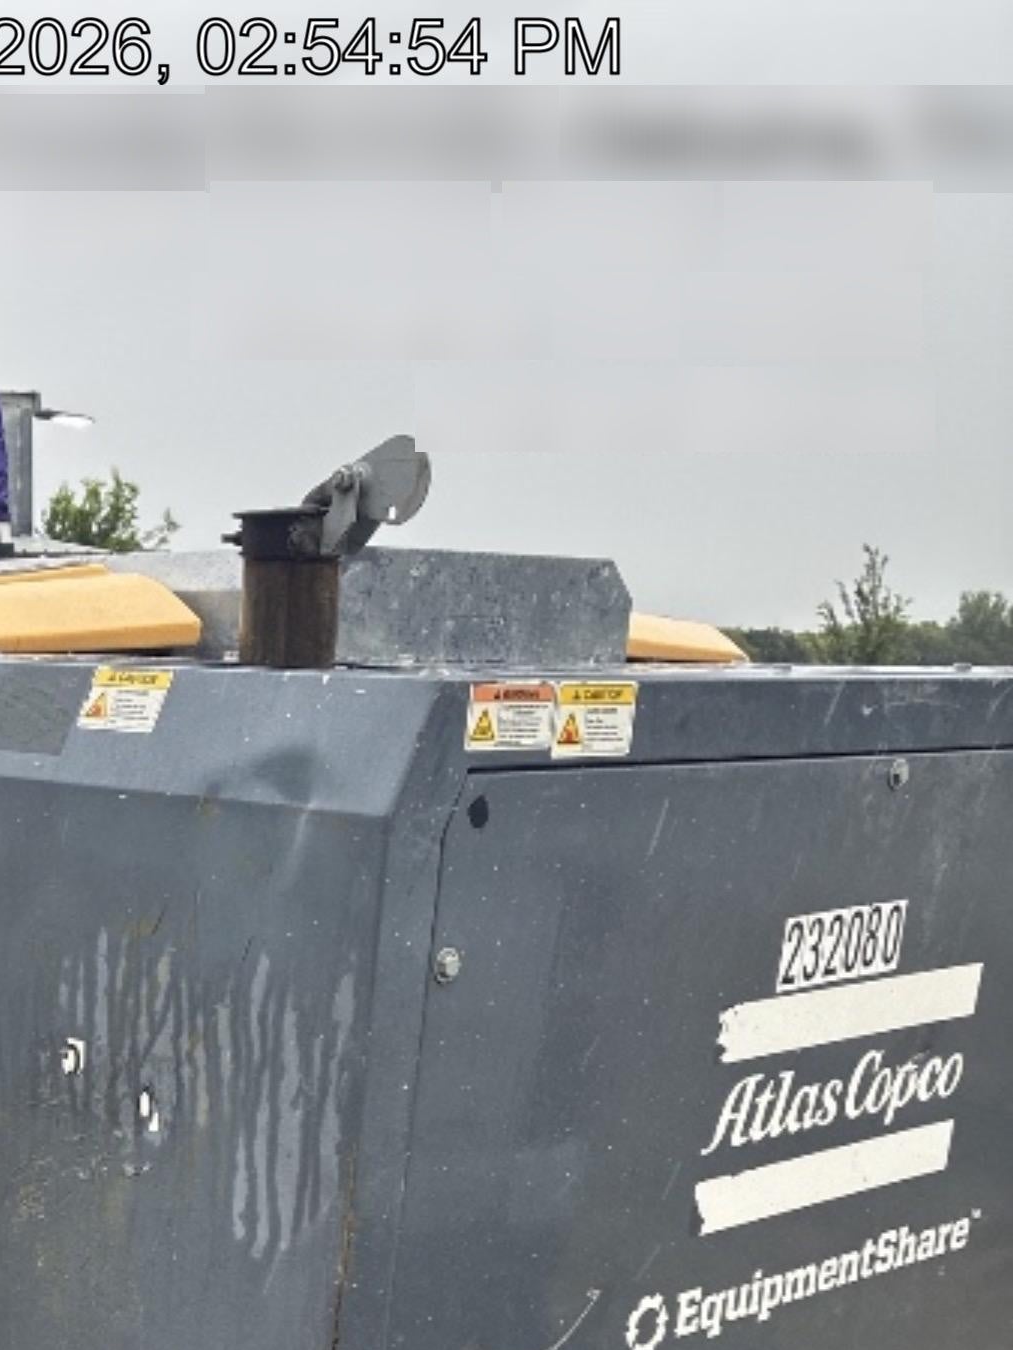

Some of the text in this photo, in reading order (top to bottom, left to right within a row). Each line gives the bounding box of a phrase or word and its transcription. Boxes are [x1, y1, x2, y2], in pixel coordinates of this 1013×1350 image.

[781, 904, 902, 984] 232080
[700, 1049, 964, 1156] Atlas Copco
[674, 1216, 972, 1339] EquipmentShare
